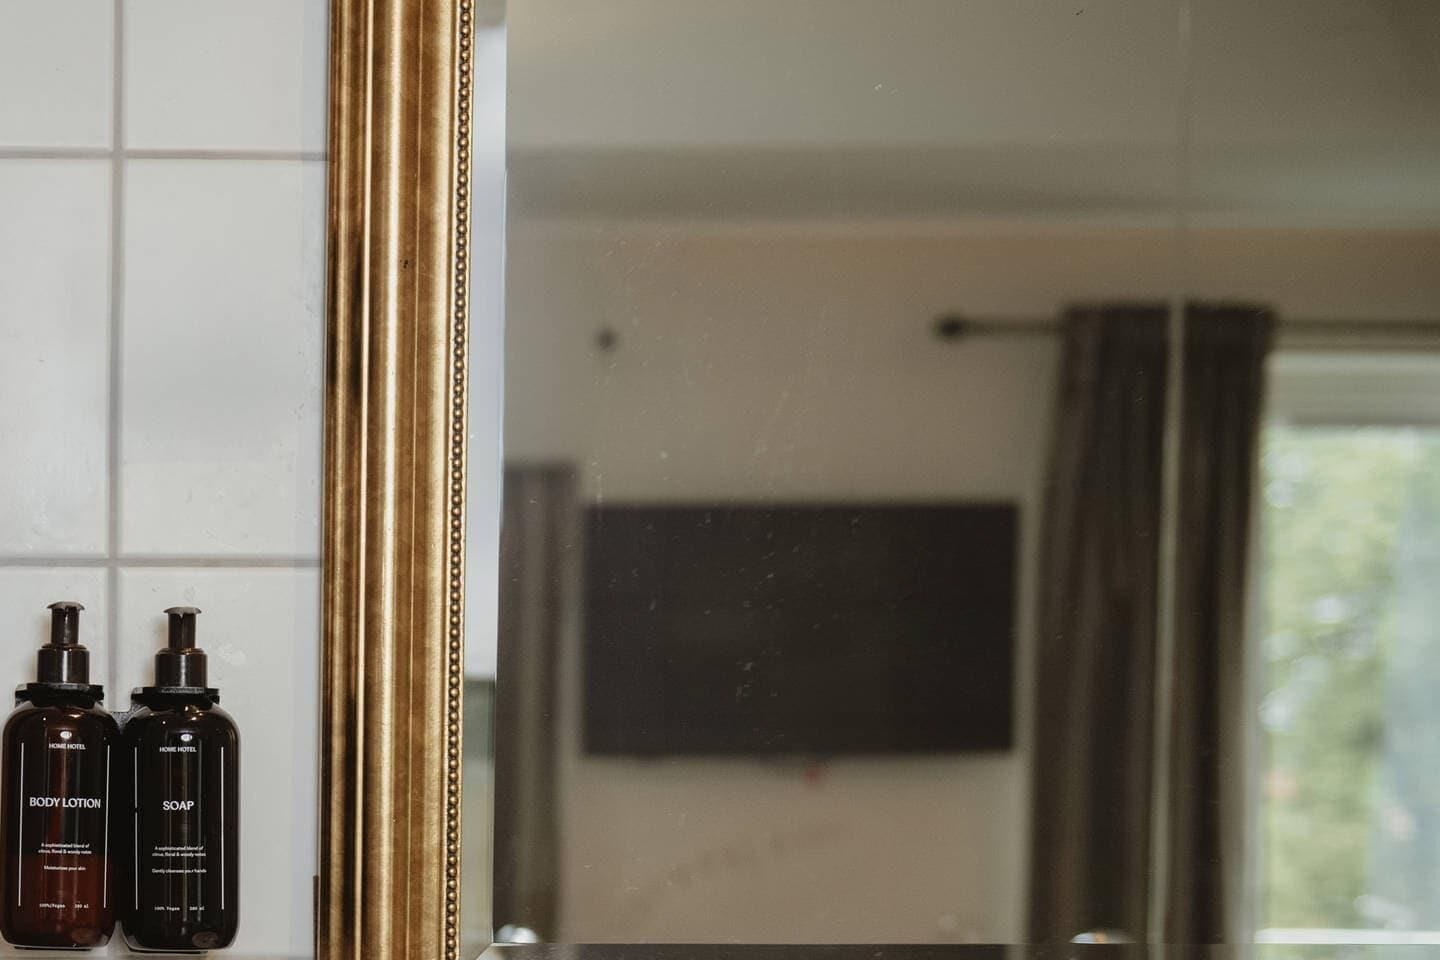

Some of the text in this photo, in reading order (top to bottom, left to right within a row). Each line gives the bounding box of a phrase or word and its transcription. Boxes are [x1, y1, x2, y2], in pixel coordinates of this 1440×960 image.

[29, 797, 101, 809] BODY LOTION
[162, 800, 195, 811] SOAP
